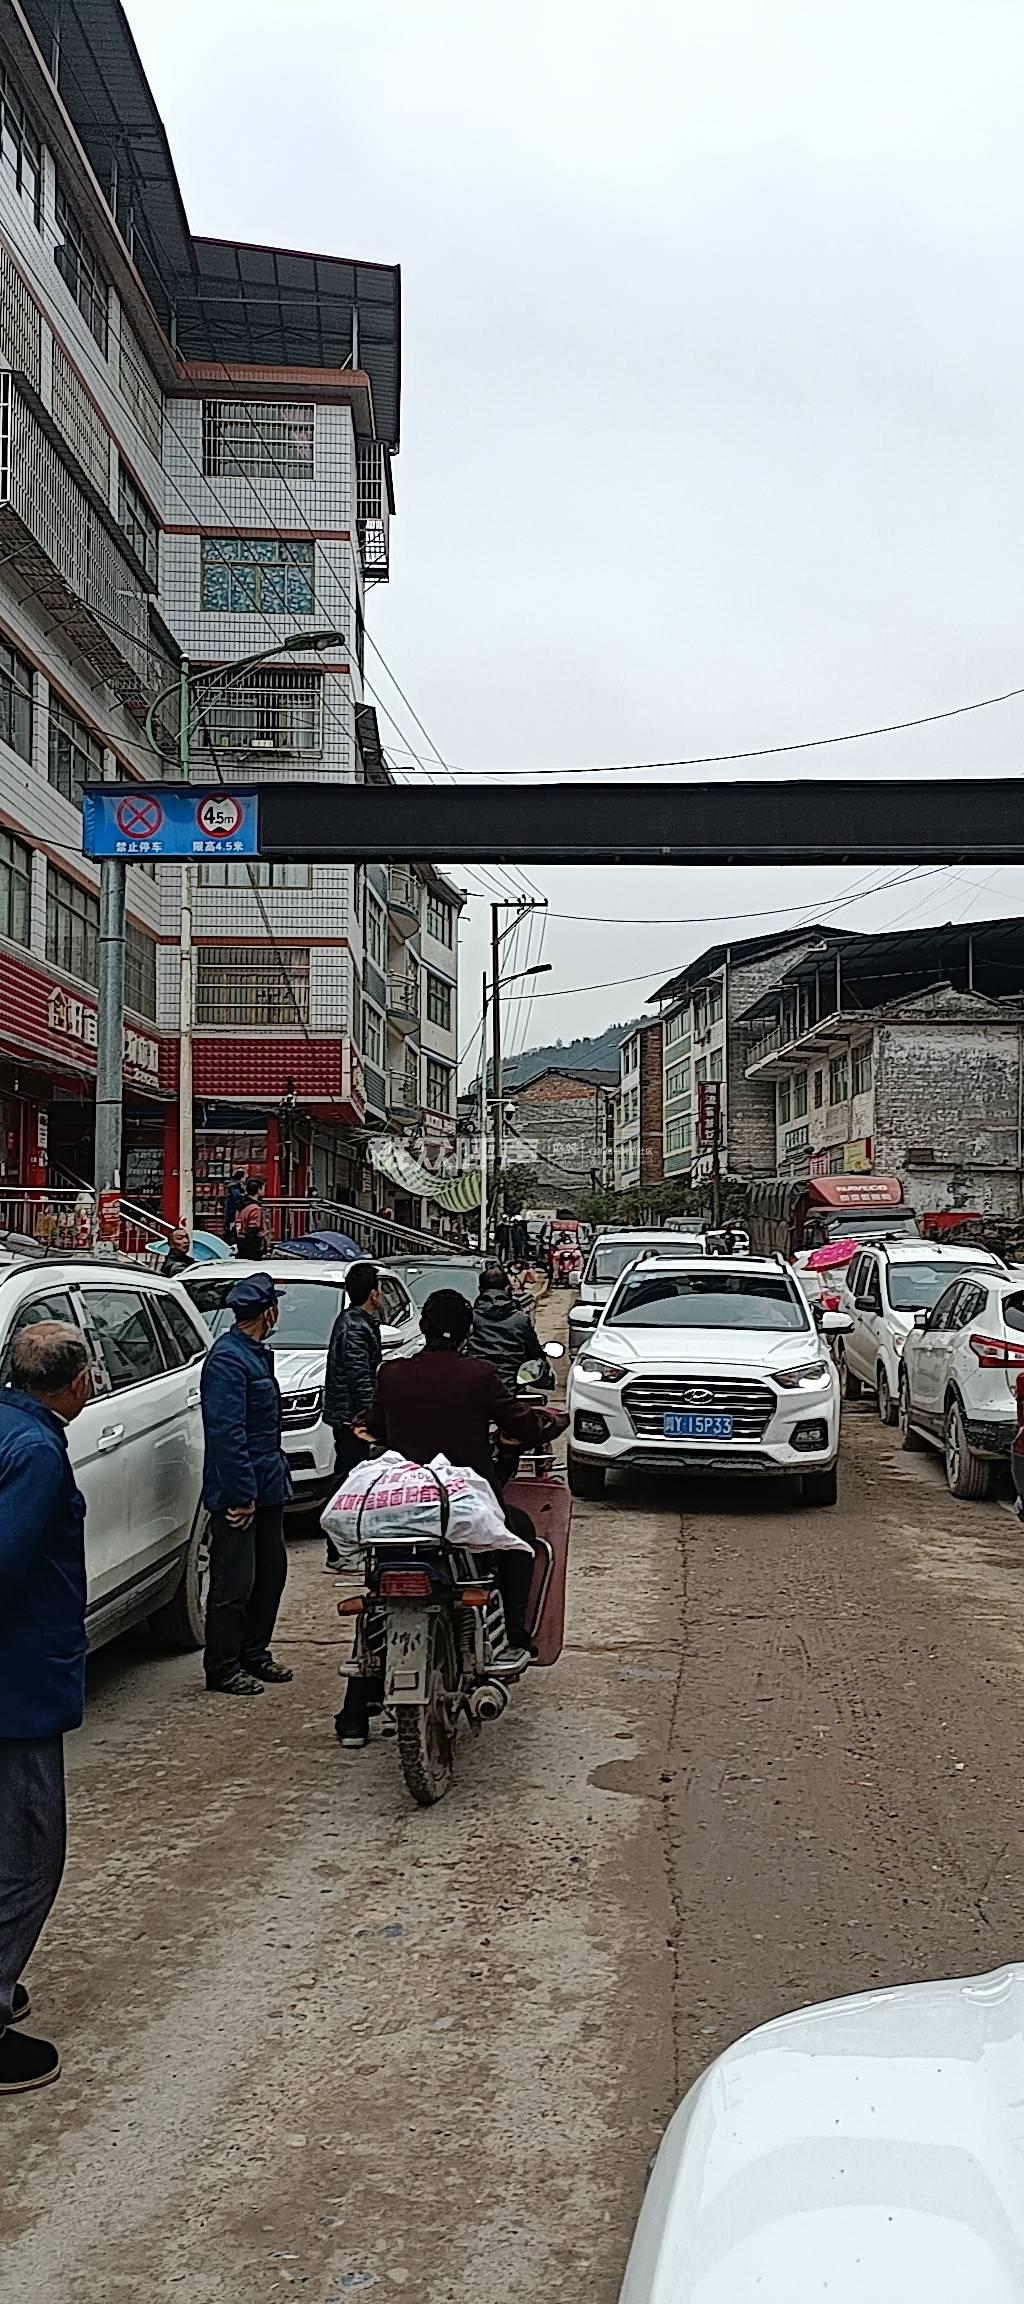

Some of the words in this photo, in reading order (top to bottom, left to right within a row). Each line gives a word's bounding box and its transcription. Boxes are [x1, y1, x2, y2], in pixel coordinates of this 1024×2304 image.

[115, 841, 163, 853] 禁止停车
[192, 840, 244, 853] 限高4.5米
